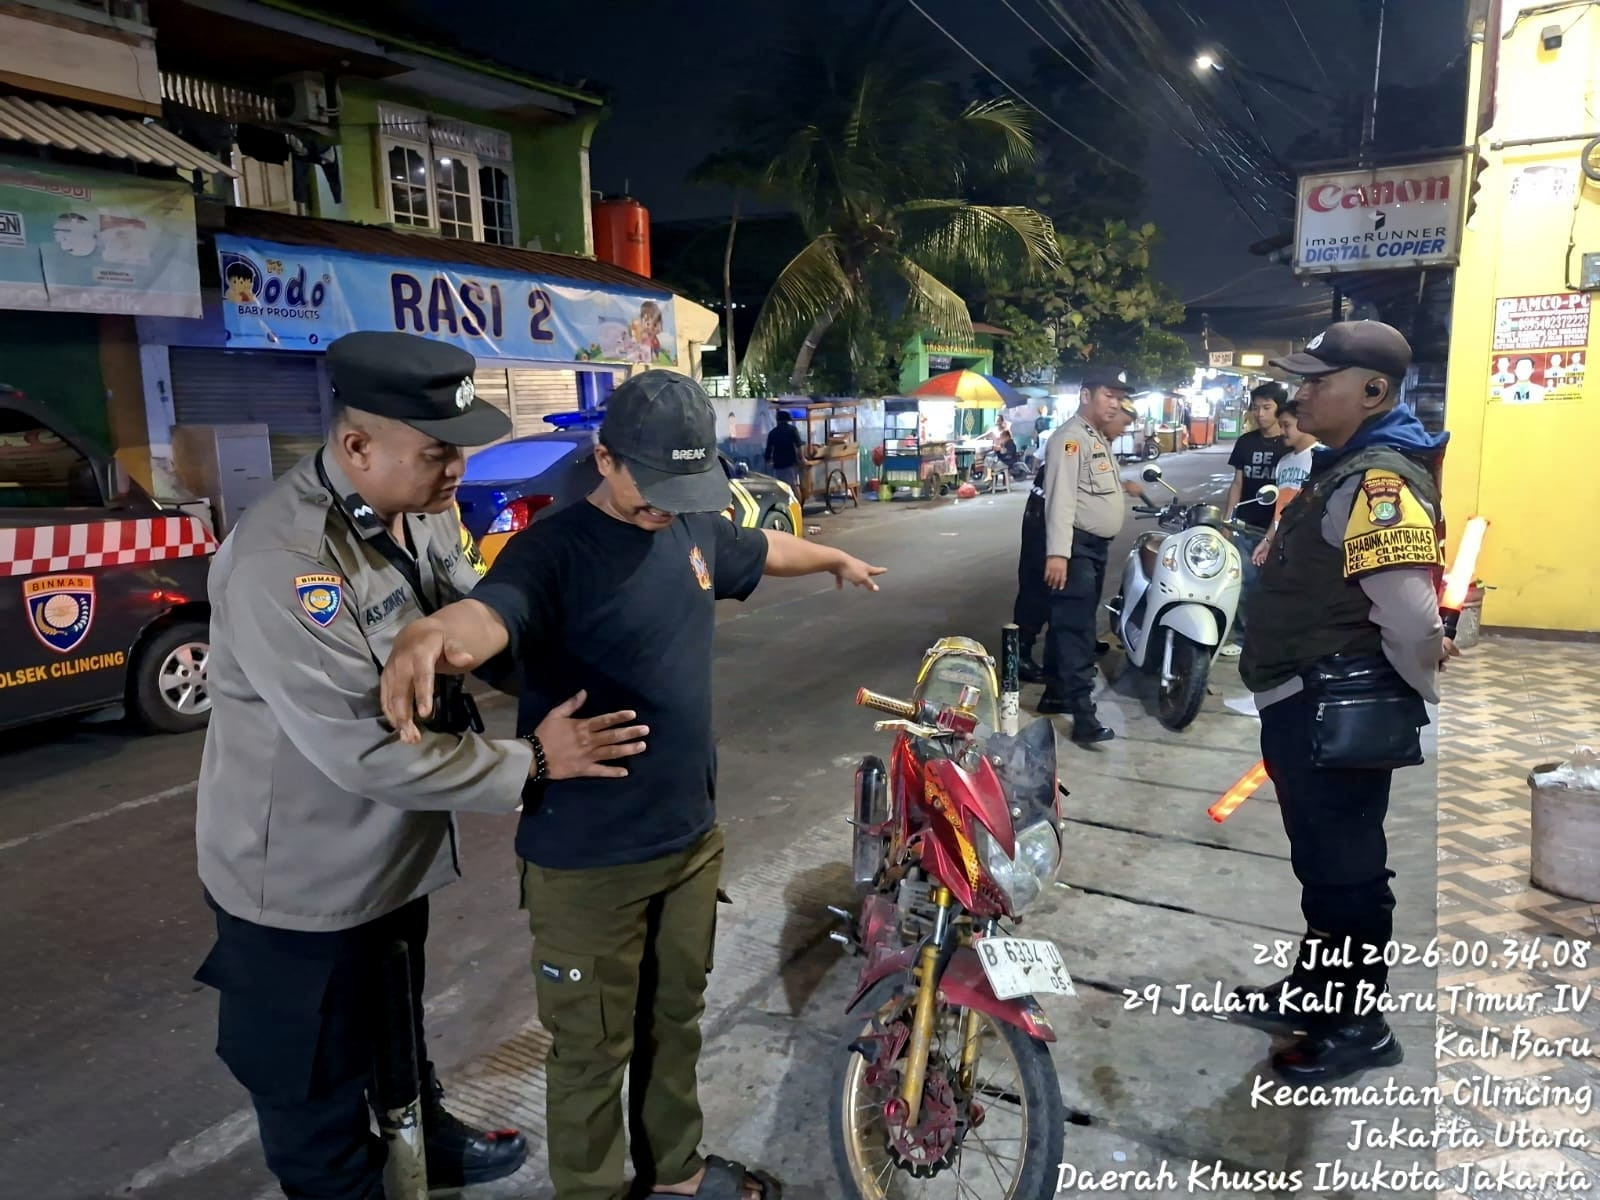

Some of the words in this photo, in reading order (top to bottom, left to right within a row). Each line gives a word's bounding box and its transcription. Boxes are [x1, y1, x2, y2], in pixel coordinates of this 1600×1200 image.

[1307, 175, 1450, 213] Canon
[1305, 227, 1446, 247] imageRUNNER
[1305, 244, 1370, 263] DIGITAL
[1376, 239, 1445, 257] COPIER
[238, 305, 264, 316] BABY
[267, 307, 320, 320] PRODUCTS
[390, 272, 502, 338] RASI
[527, 289, 554, 342] 2
[672, 448, 706, 460] BREAK
[1252, 451, 1274, 465] BE
[1347, 529, 1432, 557] BHABINKAMTIBMAS
[1375, 544, 1433, 556] CILINCING
[1376, 553, 1434, 565] CILINCING
[32, 578, 85, 592] BINMAS
[51, 651, 124, 679] CILINCING
[982, 943, 998, 967] B
